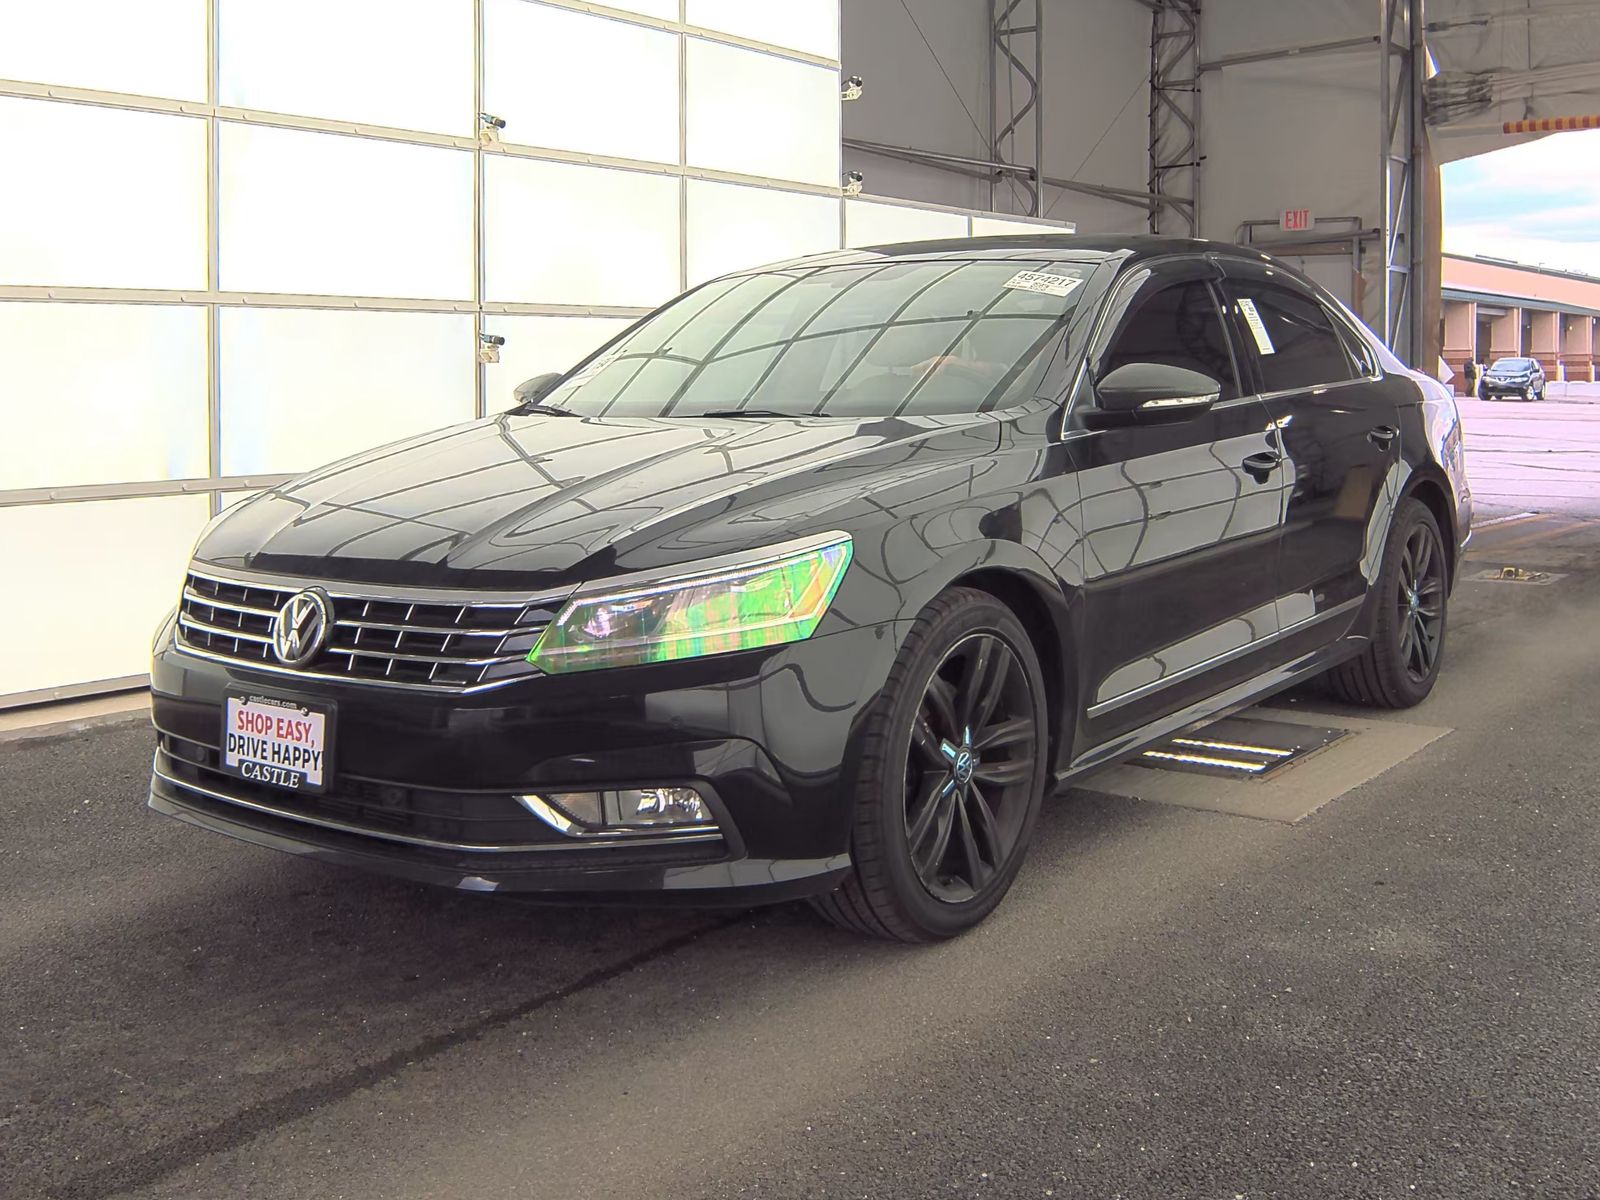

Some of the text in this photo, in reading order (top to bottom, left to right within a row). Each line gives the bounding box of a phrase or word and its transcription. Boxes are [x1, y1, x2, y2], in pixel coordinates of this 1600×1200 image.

[1285, 209, 1309, 230] EXIT
[1018, 273, 1077, 287] 4574217
[237, 710, 315, 748] SHOP EASY,
[228, 733, 321, 771] DRIVE HAPPY
[241, 761, 300, 788] CASTLE
